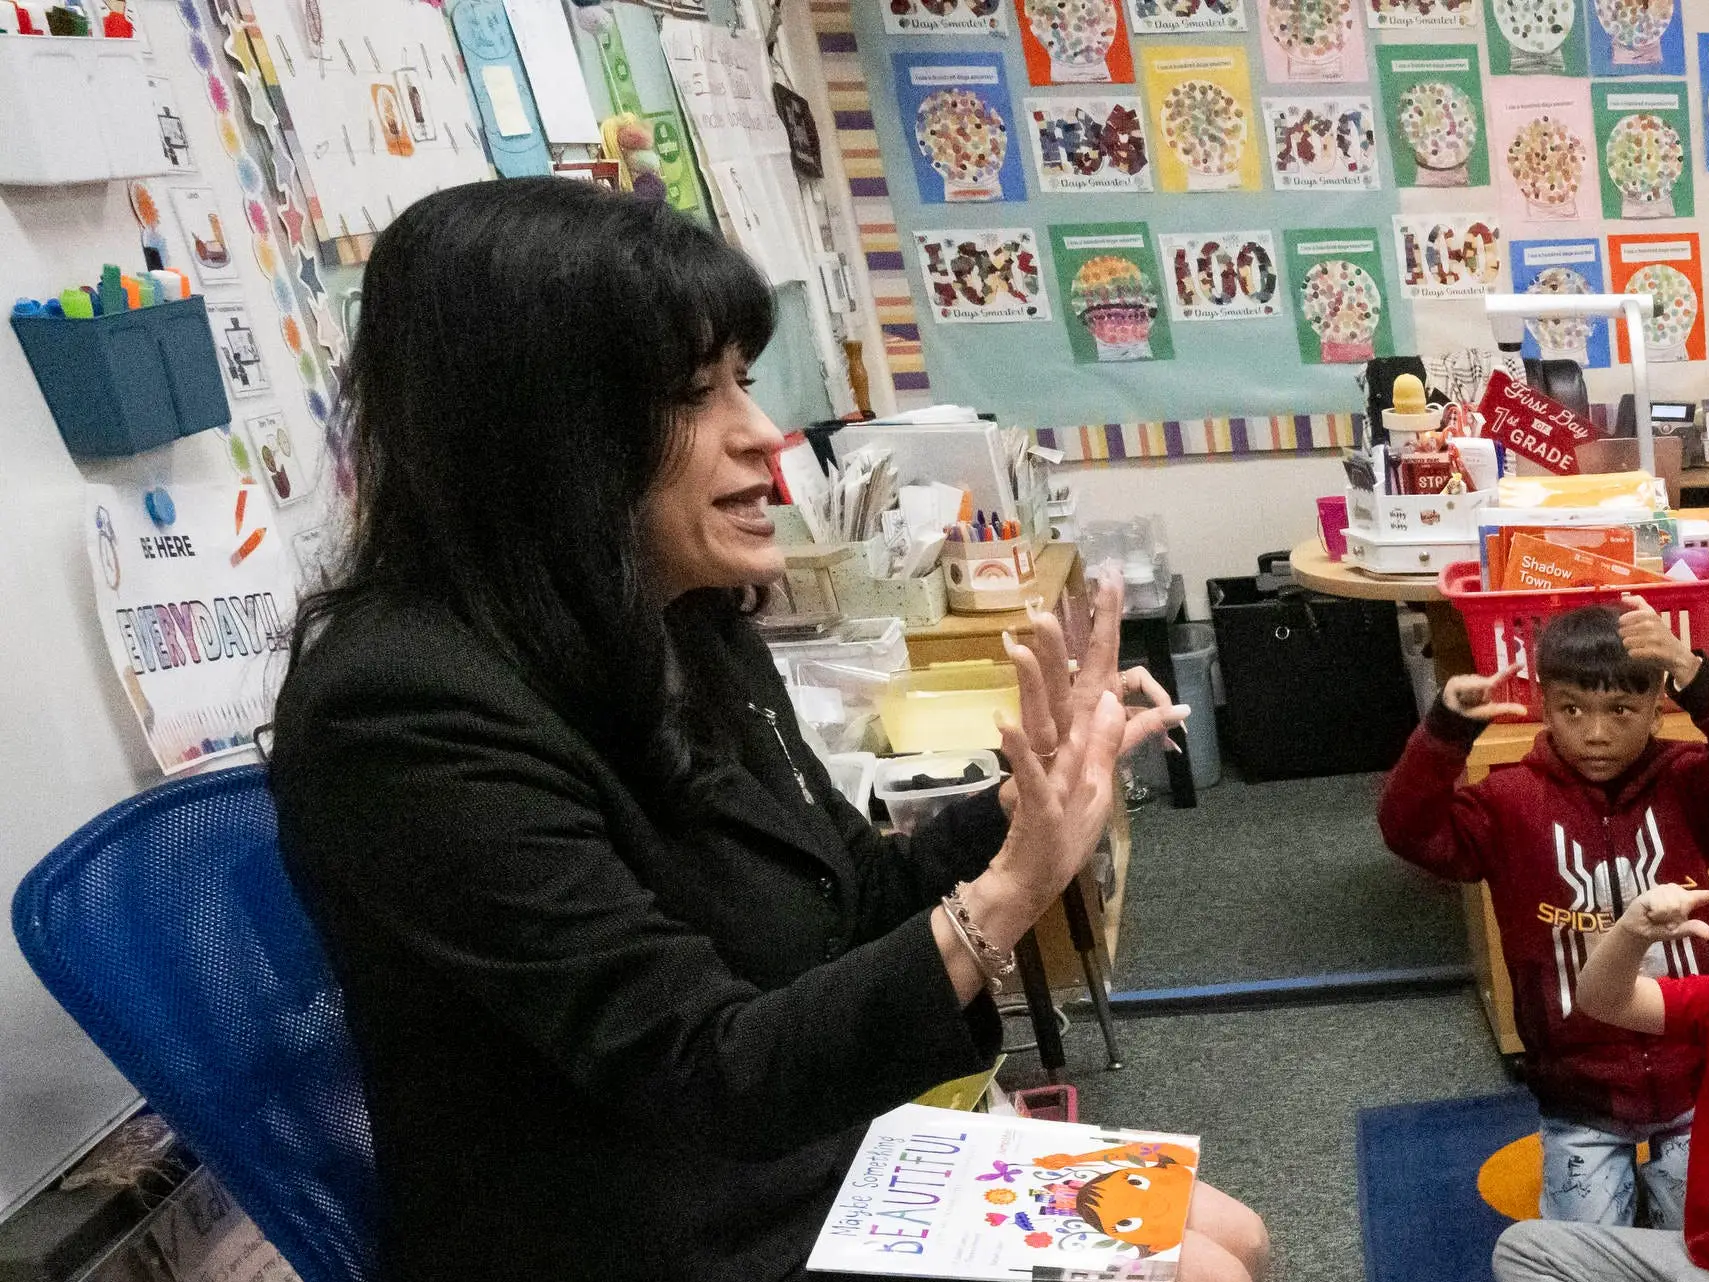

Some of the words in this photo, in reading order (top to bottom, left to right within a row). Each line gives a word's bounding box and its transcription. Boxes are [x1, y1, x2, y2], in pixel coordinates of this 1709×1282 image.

[1168, 241, 1276, 305] 100
[1491, 406, 1519, 433] 1st
[1504, 378, 1547, 414] First
[1550, 409, 1588, 440] Day
[1509, 429, 1575, 472] GRADE
[140, 537, 156, 559] BE
[156, 535, 196, 557] HERE
[1521, 556, 1572, 580] Shadow
[1520, 569, 1552, 590] Town
[116, 592, 289, 675] EVERYDAY!!
[1537, 902, 1616, 934] SPIDE
[831, 1195, 873, 1238] Maybe
[861, 1133, 905, 1194] Something
[870, 1131, 968, 1256] BEAUTIFUL
